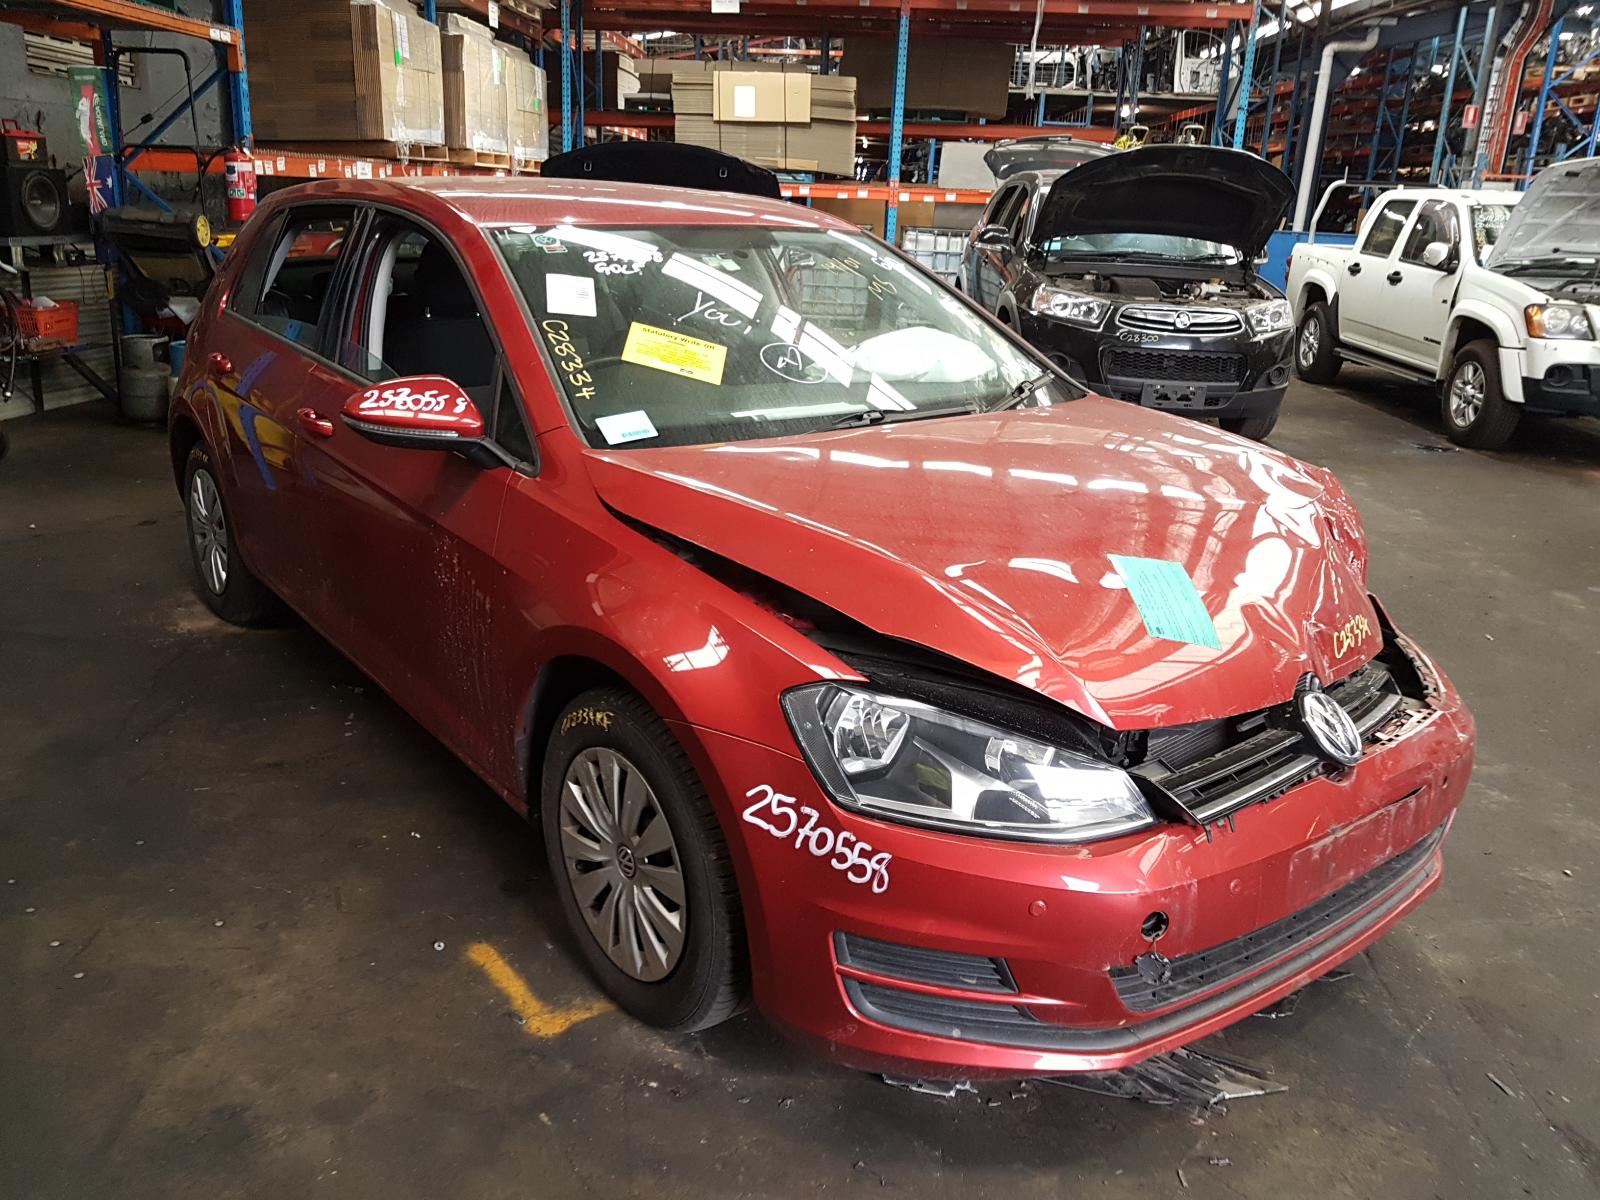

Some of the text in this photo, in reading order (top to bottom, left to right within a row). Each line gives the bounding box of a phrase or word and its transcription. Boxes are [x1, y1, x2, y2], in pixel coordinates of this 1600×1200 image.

[542, 319, 596, 400] C28334
[1119, 331, 1159, 343] C28300
[742, 784, 893, 894] 2570558
